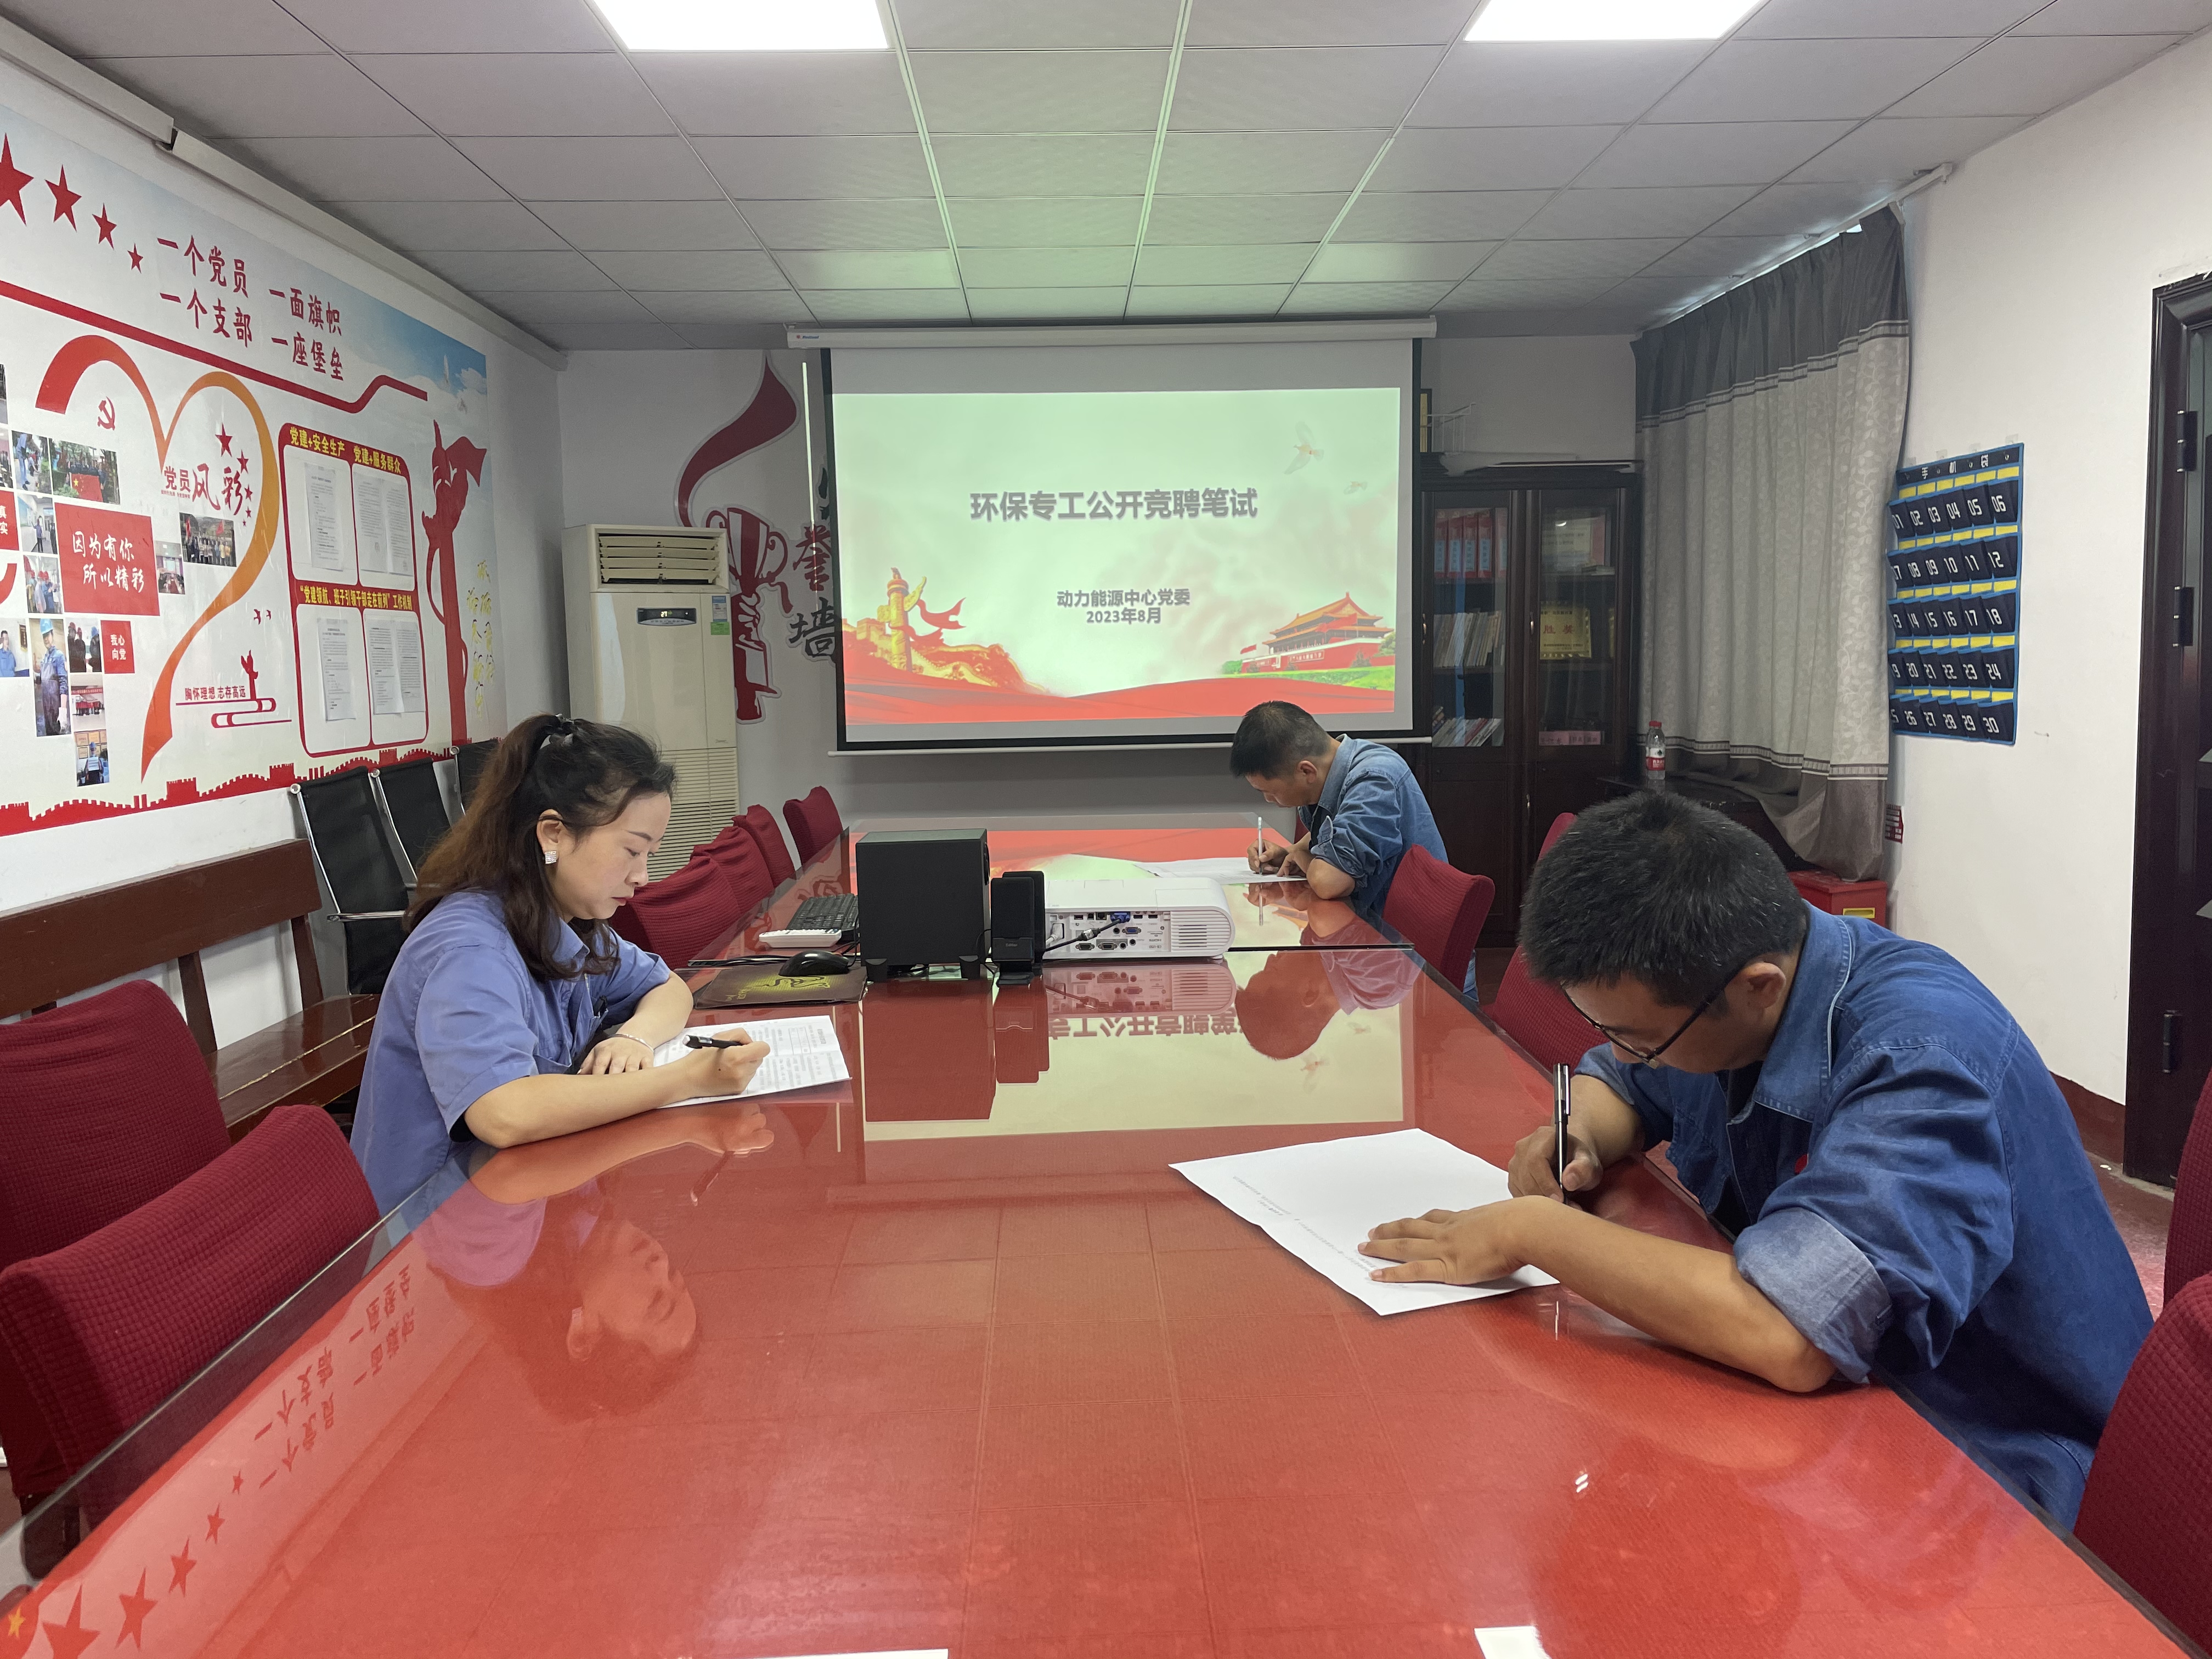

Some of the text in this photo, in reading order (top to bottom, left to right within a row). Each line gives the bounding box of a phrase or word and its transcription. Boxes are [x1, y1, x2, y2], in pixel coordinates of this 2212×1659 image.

[157, 235, 342, 336] 一个党员 一面旗帜
[160, 287, 344, 381] 一个支部 一座堡垒
[290, 426, 401, 474] 党建+安全生产 党建+服务群众
[970, 487, 1259, 522] 环保专工公开竞聘笔试
[1910, 510, 1923, 526] 02
[1927, 506, 1941, 523] 03
[1946, 501, 1961, 520] 04
[1967, 498, 1982, 516] 05
[1991, 494, 2006, 512] 06
[72, 531, 135, 562] 因为有你
[83, 563, 145, 593] 所以精彩
[1908, 562, 1921, 578] 08
[1925, 559, 1939, 575] 09
[1943, 557, 1959, 573] 10
[1965, 554, 1980, 571] 11
[1988, 551, 2004, 568] 12
[1057, 588, 1190, 608] 动力能源中心党委
[1086, 607, 1162, 624] 2023年8月
[1907, 613, 1920, 629] 14
[1924, 611, 1938, 628] 15
[1943, 611, 1957, 627] 16
[1965, 609, 1978, 627] 17
[1986, 608, 2002, 625] 18
[1906, 663, 1919, 678] 20
[1923, 664, 1937, 679] 21
[1942, 664, 1957, 680] 22
[1962, 664, 1978, 680] 23
[1985, 663, 2002, 680] 24
[184, 685, 246, 701] 胸怀理想 志存高远
[1891, 709, 2000, 733] 5 26 27 28 29 30
